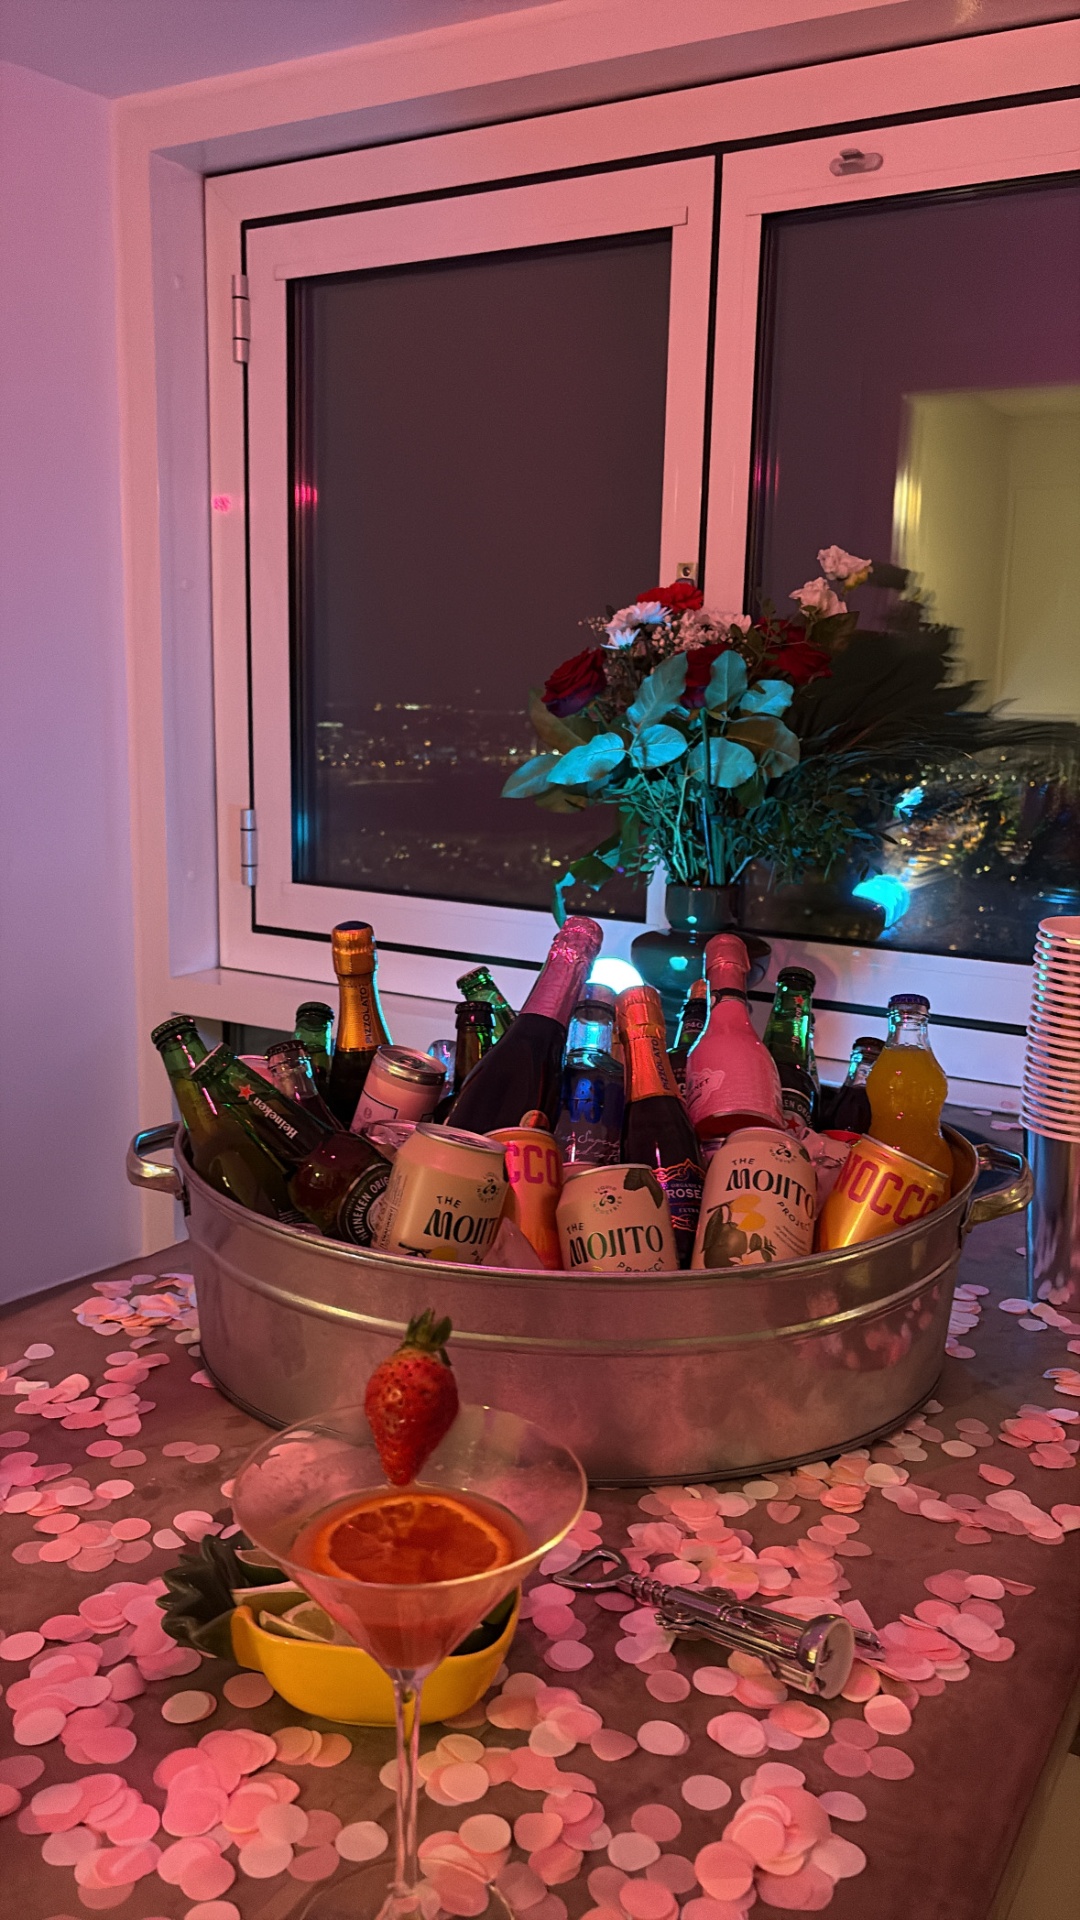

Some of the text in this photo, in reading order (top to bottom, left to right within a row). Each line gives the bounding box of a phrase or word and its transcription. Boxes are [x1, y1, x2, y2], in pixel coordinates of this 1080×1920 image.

[359, 986, 373, 1044] PIZZOLATO
[252, 1097, 298, 1139] Heineken
[732, 1158, 755, 1166] THE
[436, 1195, 462, 1209] THE
[725, 1168, 815, 1220] MOJITO
[352, 1192, 372, 1241] HEINEKEN
[566, 1222, 585, 1235] THE
[569, 1225, 664, 1268] MOJITO
